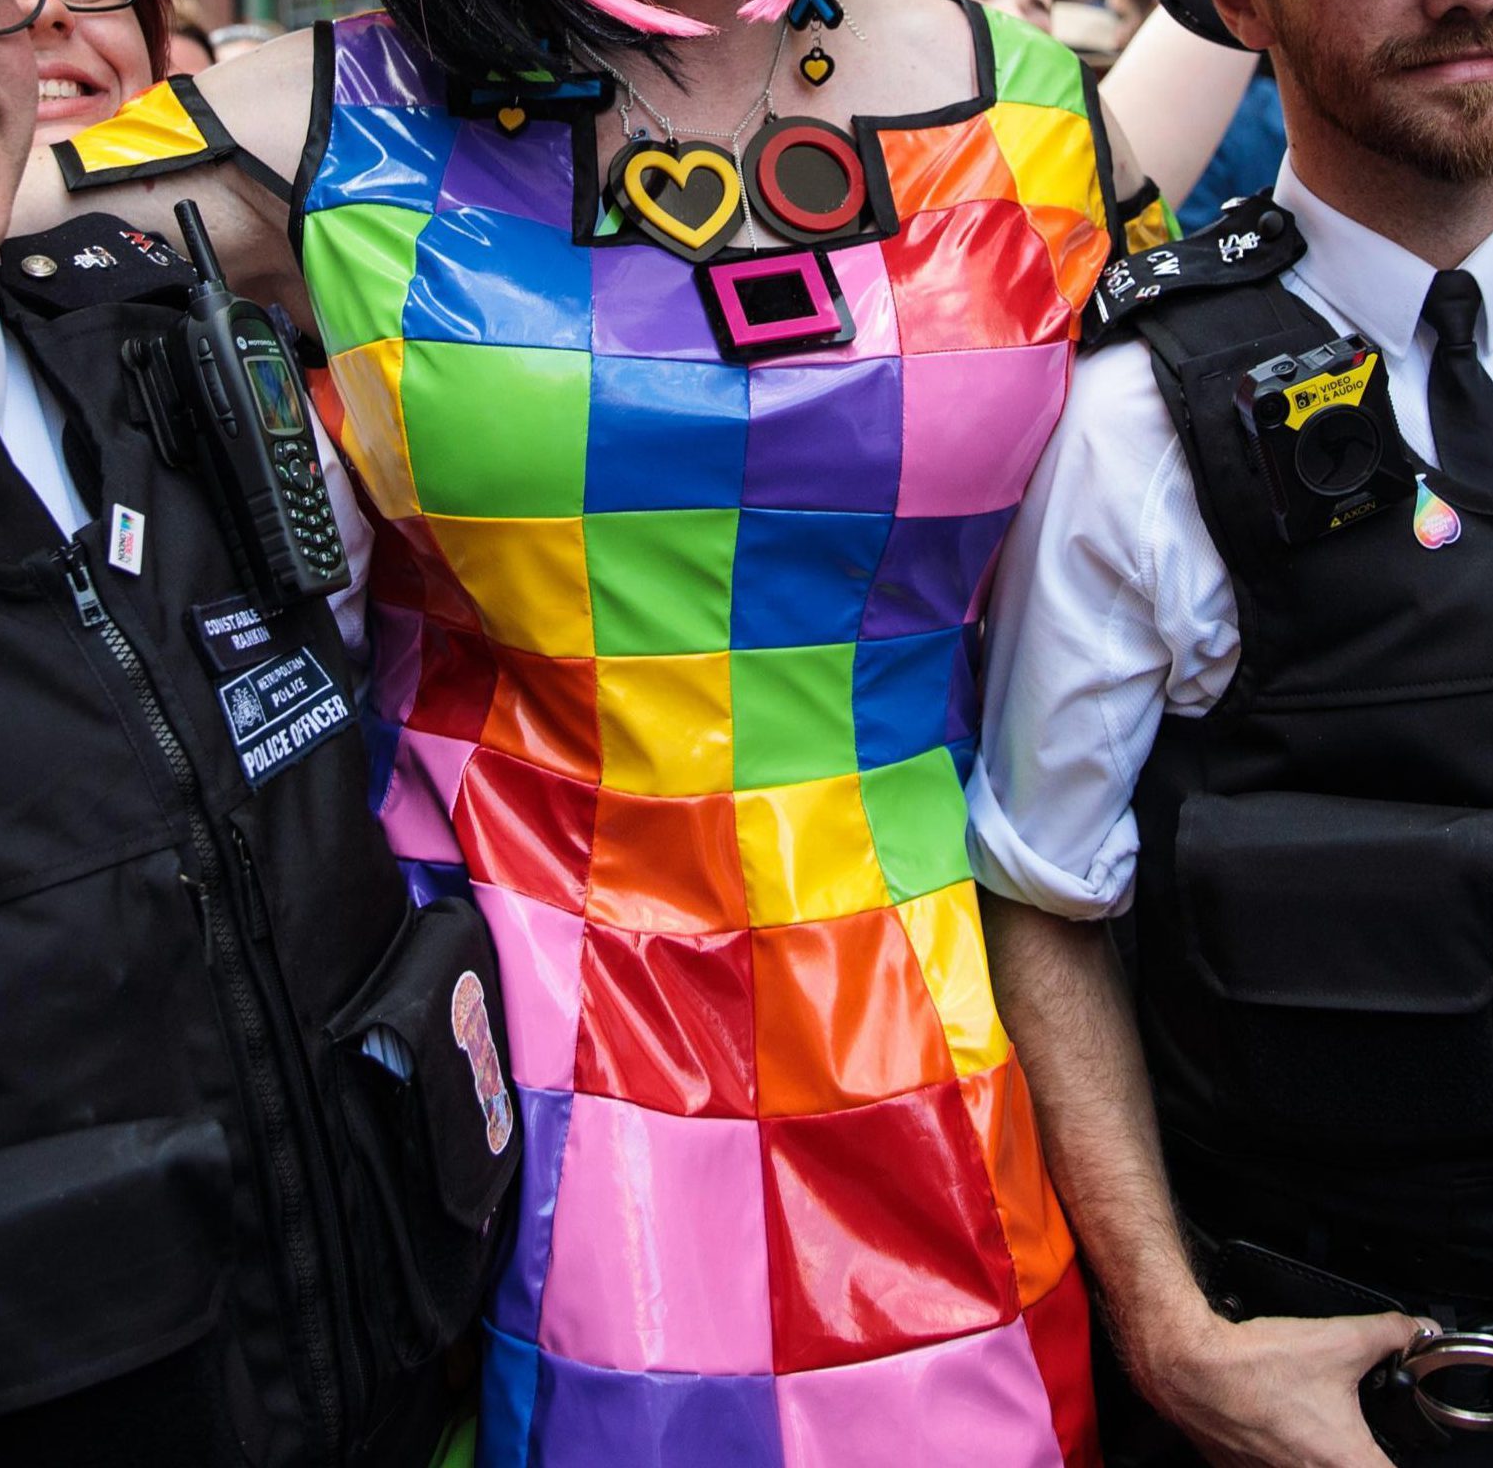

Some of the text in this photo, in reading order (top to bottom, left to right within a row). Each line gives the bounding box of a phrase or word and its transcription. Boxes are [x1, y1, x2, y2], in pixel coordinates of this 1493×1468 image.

[1146, 250, 1181, 276] CW
[1320, 376, 1351, 393] VIDEO
[1323, 380, 1364, 403] & AUDIO
[1343, 501, 1376, 522] AXON
[204, 608, 261, 636] CONSTABLE
[230, 626, 271, 651] RANKIN
[258, 656, 306, 692] METROPOLITAN
[271, 677, 308, 708] POLICE
[242, 694, 349, 778] POLICE OFFICER
